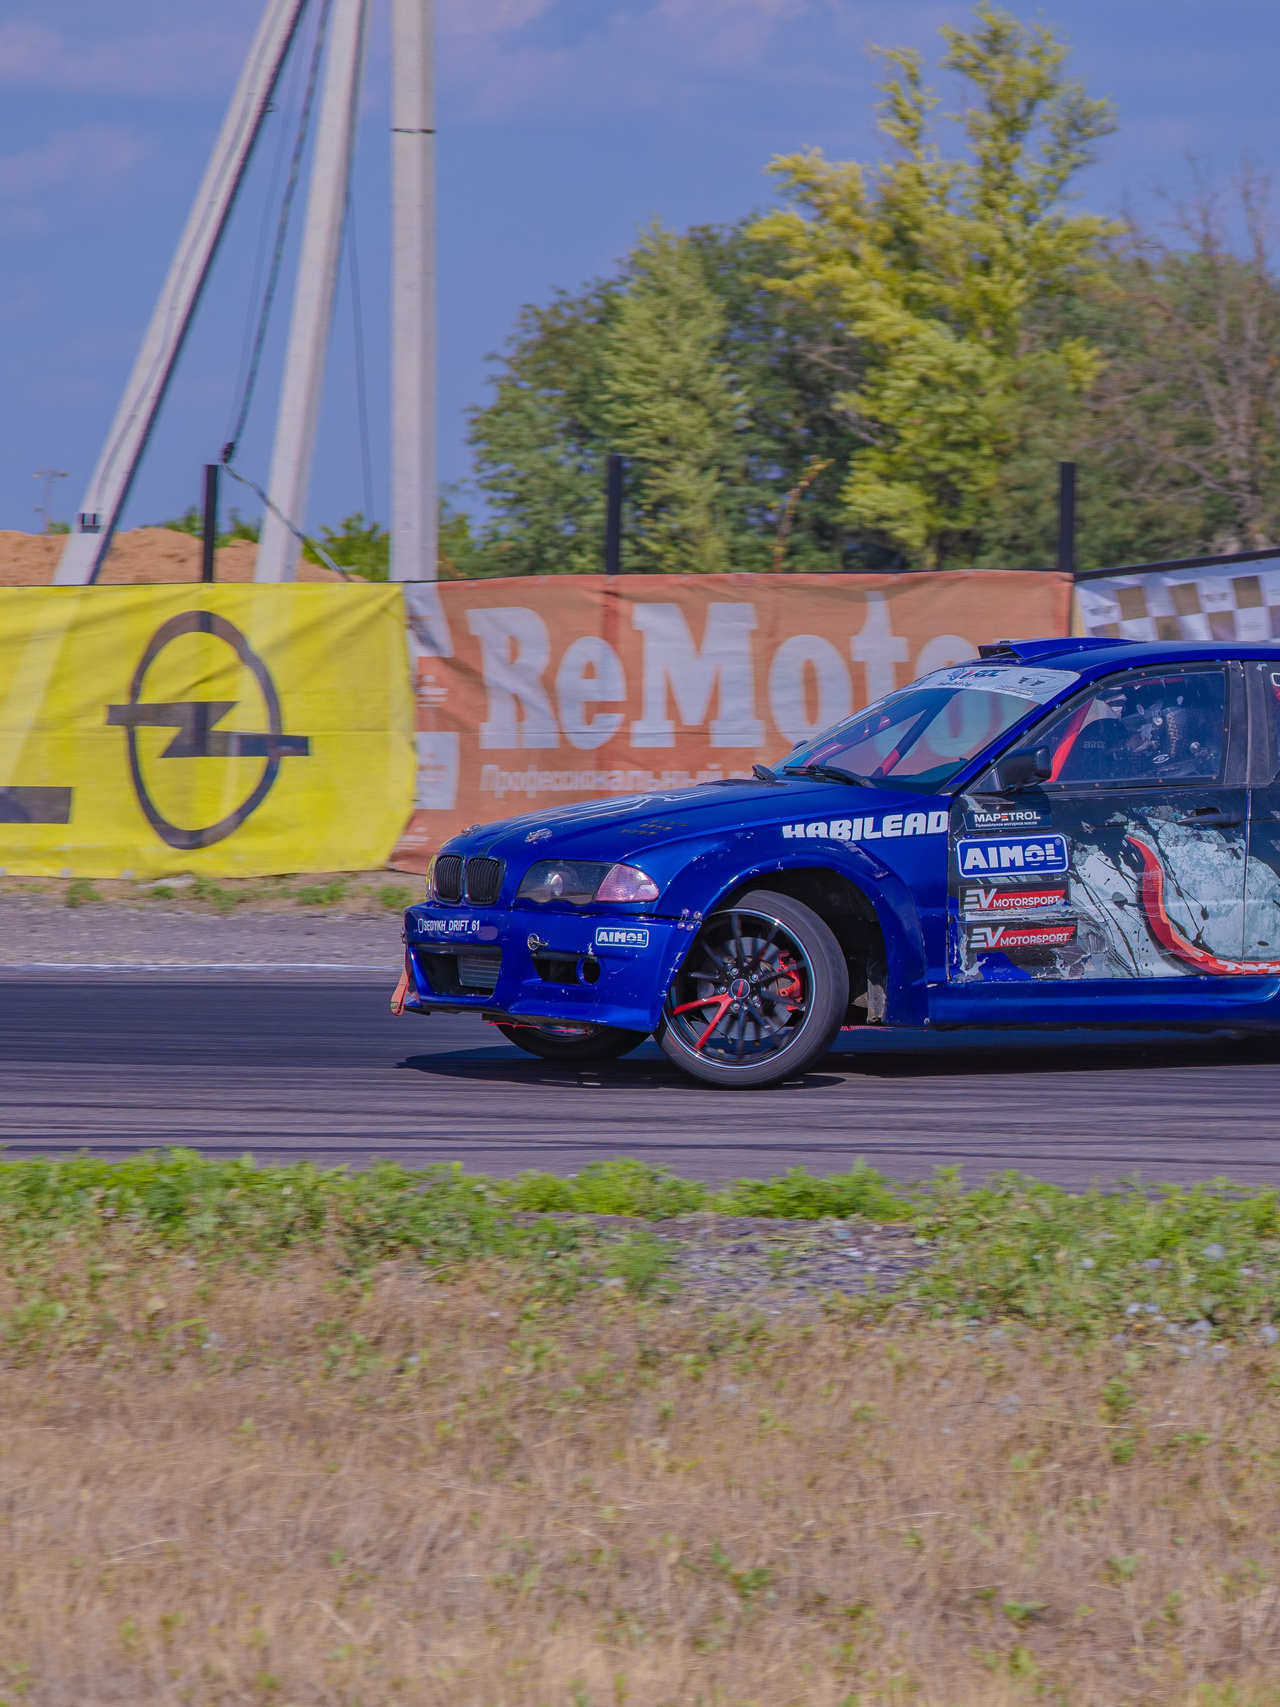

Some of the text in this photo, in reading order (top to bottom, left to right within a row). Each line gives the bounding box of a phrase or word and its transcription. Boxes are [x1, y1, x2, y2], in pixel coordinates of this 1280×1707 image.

[974, 811, 1041, 823] MAPETROL
[782, 811, 949, 841] HABILEAD
[993, 895, 1060, 908] MOTORSPORT
[423, 919, 480, 934] SEDYKH_DRIFT_61
[1000, 933, 1069, 946] MOTORSPORT
